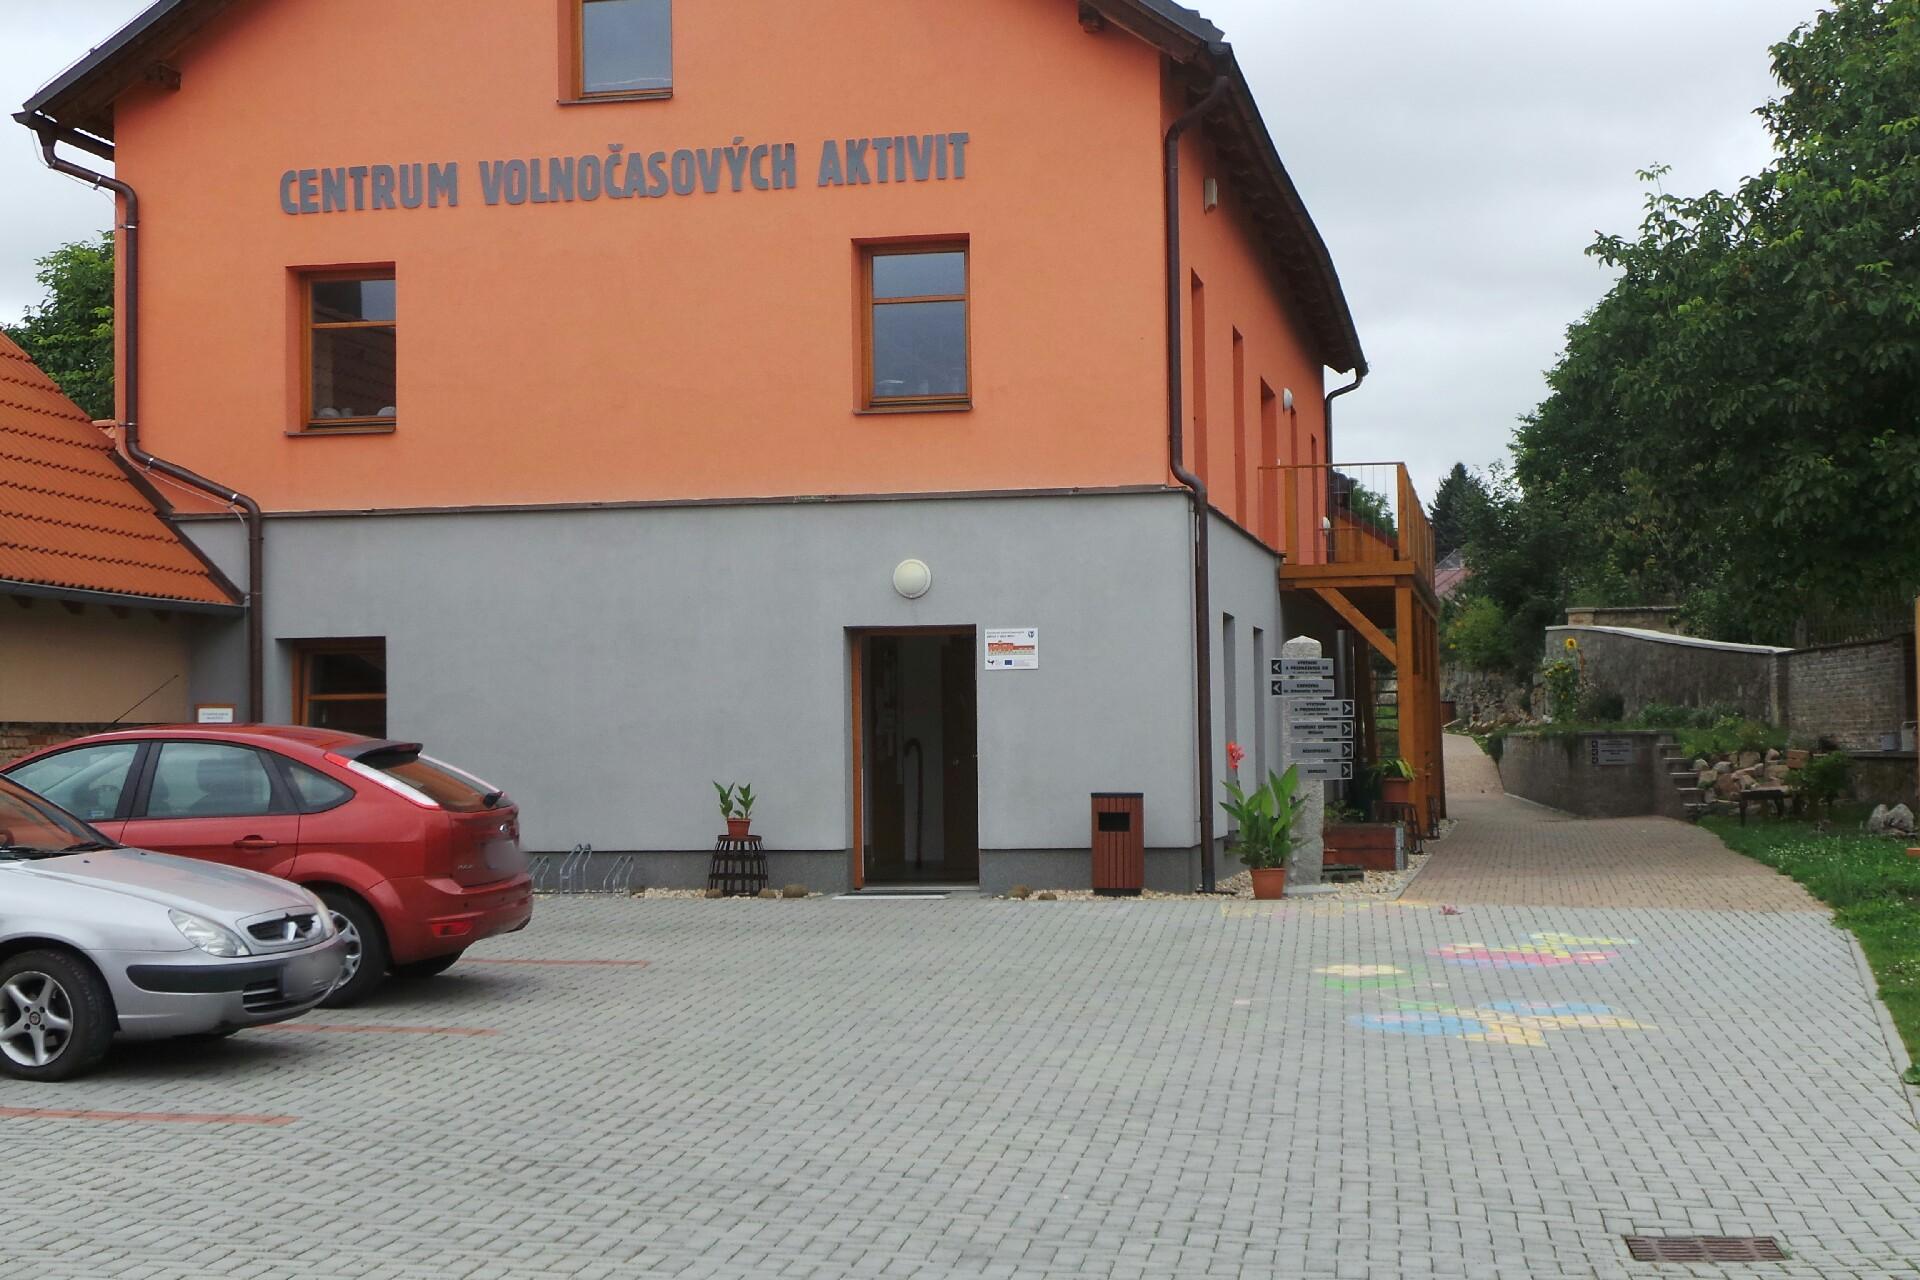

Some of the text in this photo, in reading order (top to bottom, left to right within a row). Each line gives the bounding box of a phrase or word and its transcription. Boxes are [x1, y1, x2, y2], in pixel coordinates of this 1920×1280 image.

[280, 132, 969, 215] CENTRUM VOLNOČASOVÝCH AKTIVIT
